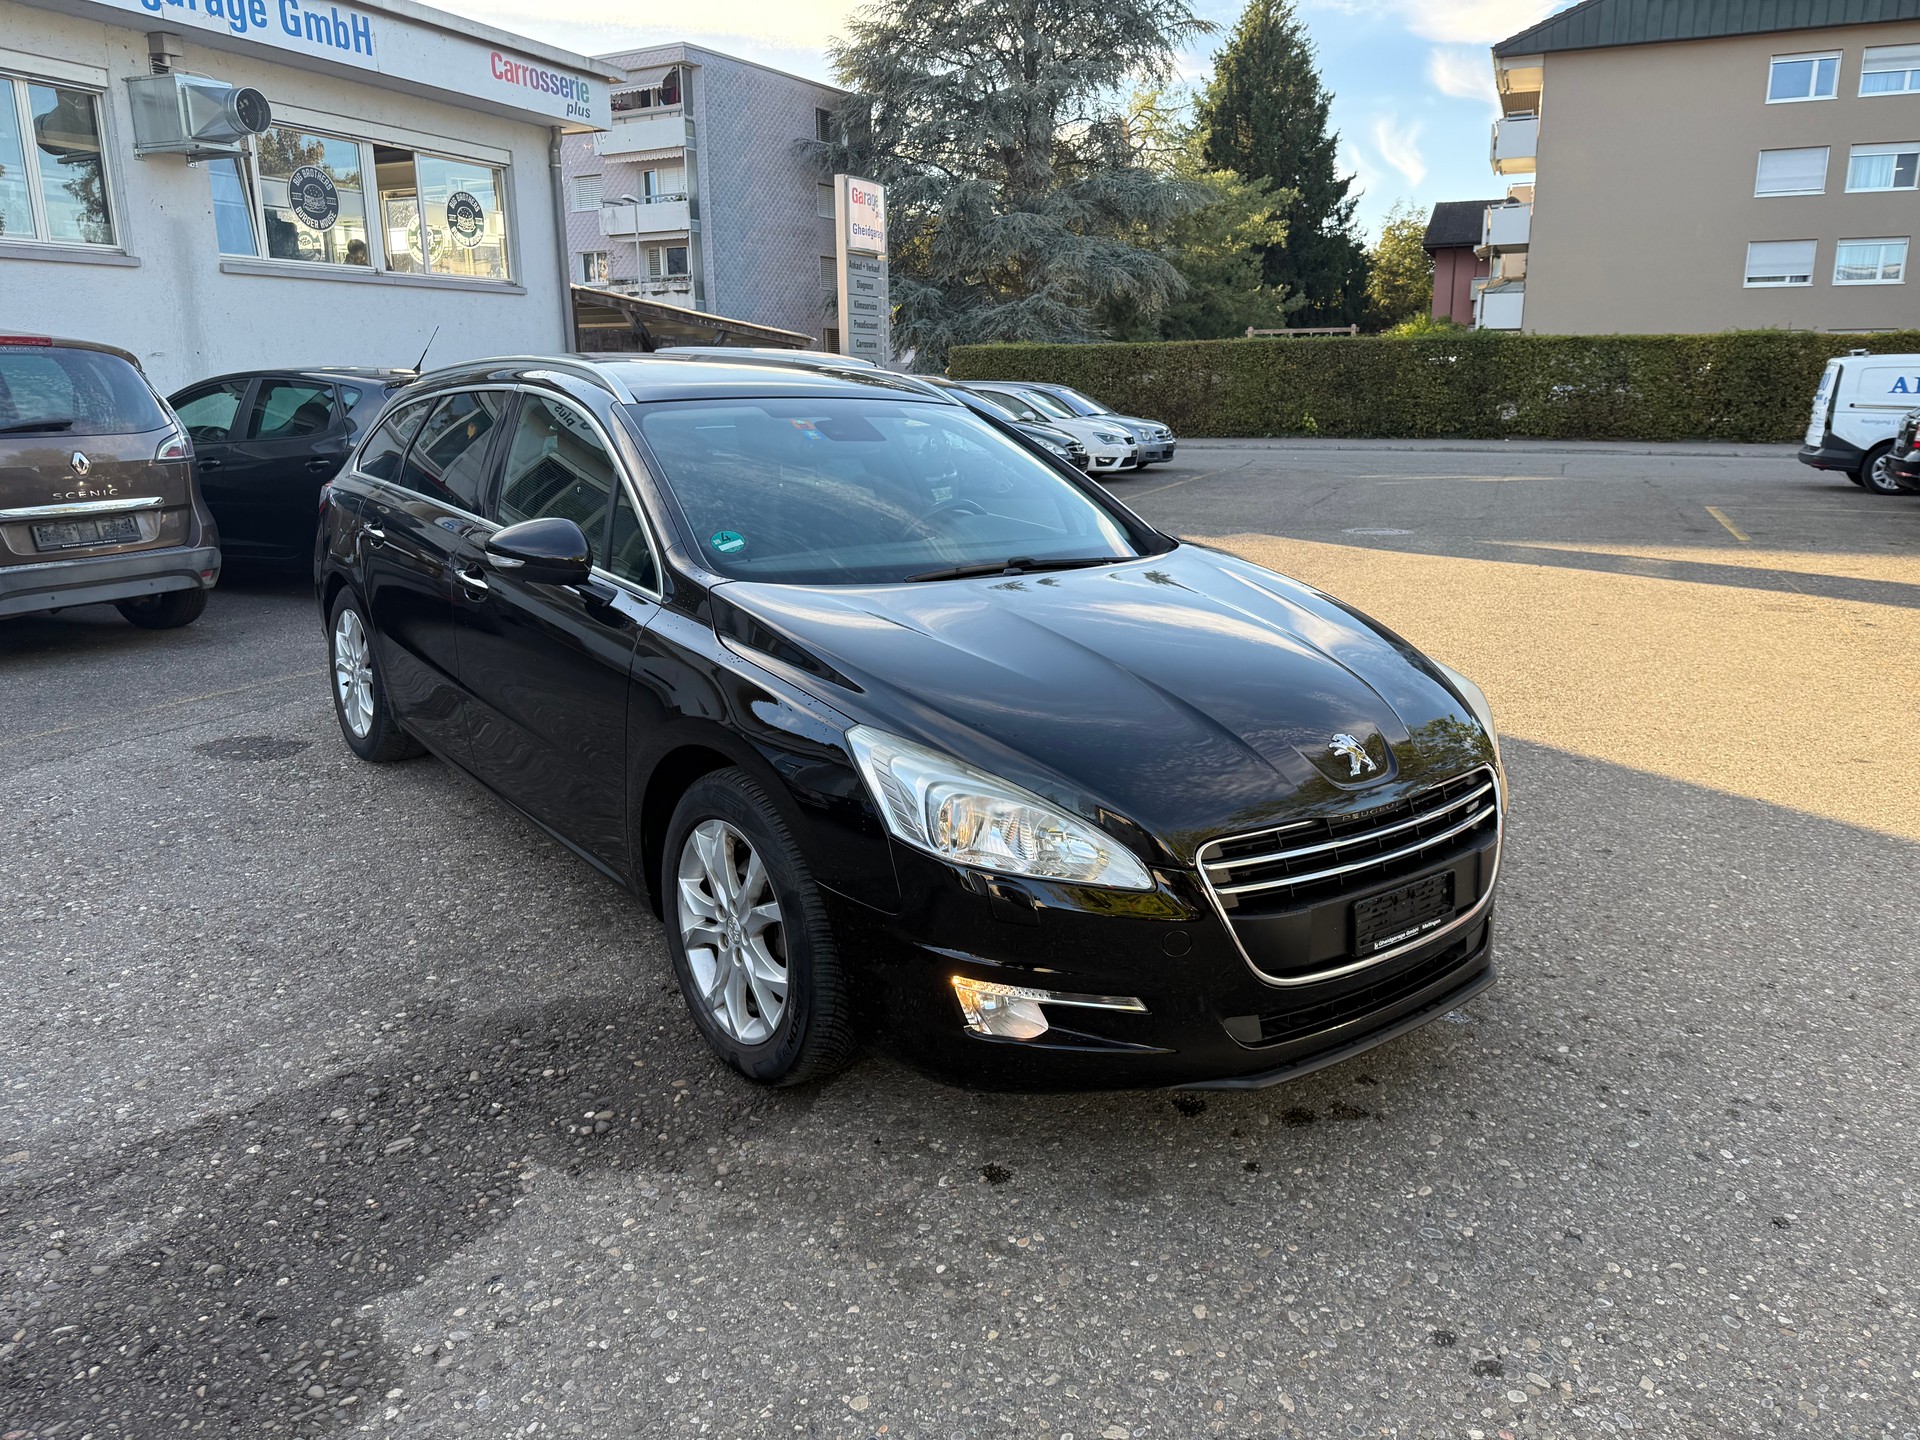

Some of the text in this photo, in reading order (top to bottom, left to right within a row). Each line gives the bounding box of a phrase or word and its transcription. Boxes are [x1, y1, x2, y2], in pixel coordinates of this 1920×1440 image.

[278, 0, 373, 57] GmbH
[490, 51, 590, 104] Carrosserie
[566, 101, 591, 119] plus
[292, 168, 333, 191] BIG BROTHERS
[852, 187, 879, 212] Garage
[295, 206, 337, 229] BURGER HOUSE
[852, 222, 884, 242] Gheidgarage
